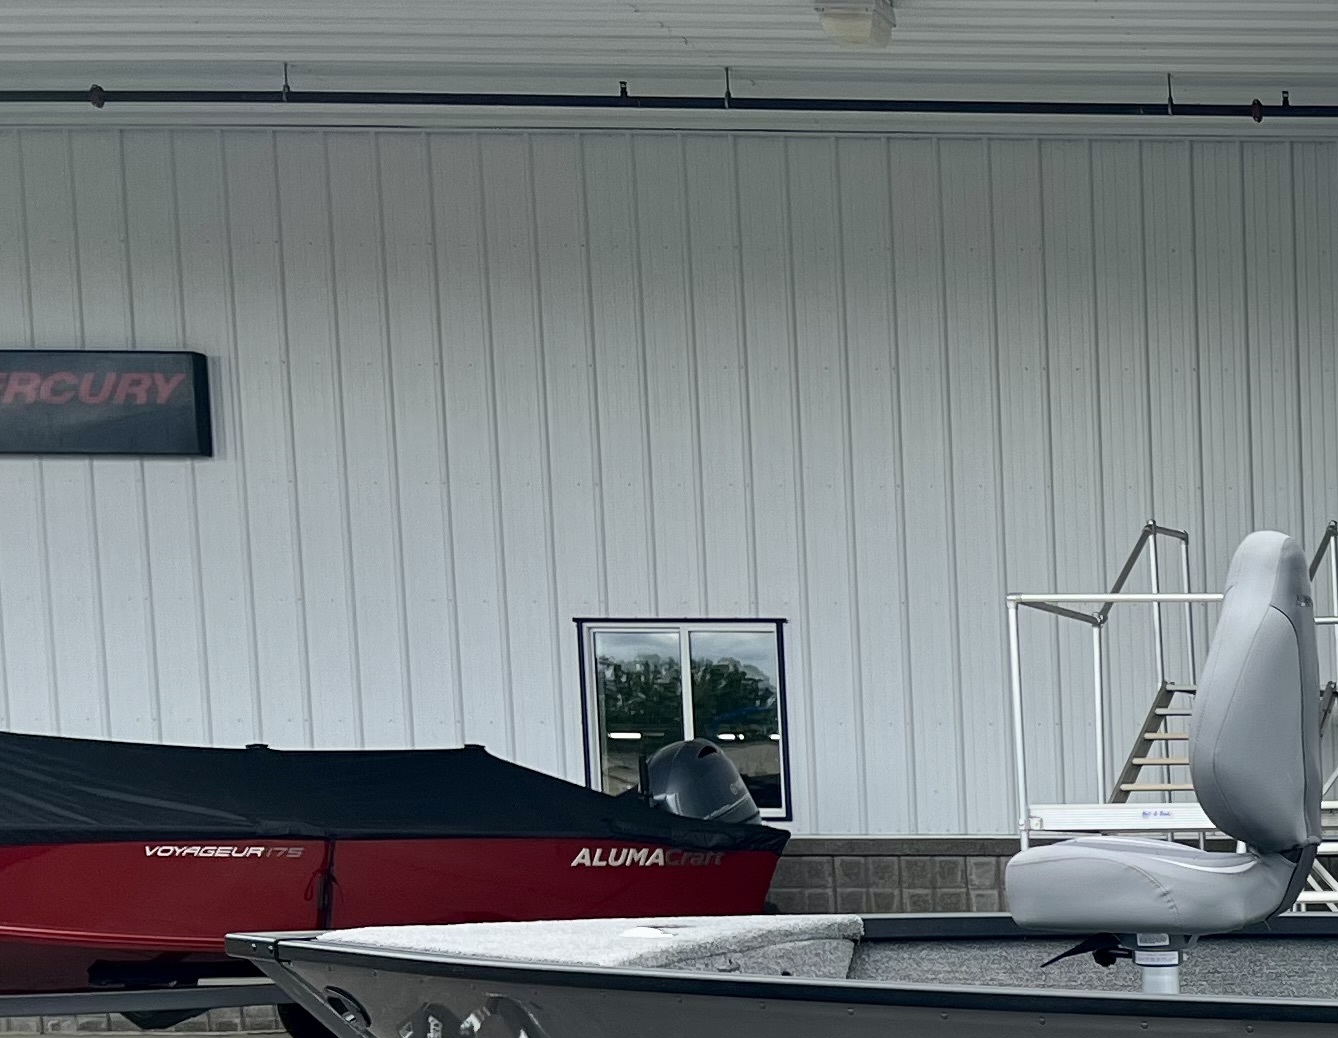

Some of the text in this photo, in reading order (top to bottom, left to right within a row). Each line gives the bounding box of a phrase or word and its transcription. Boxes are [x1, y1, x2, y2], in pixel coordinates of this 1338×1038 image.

[0, 371, 187, 405] RCURY
[145, 845, 305, 858] VOYAGEUR 175
[571, 847, 723, 867] ALUMACraft
